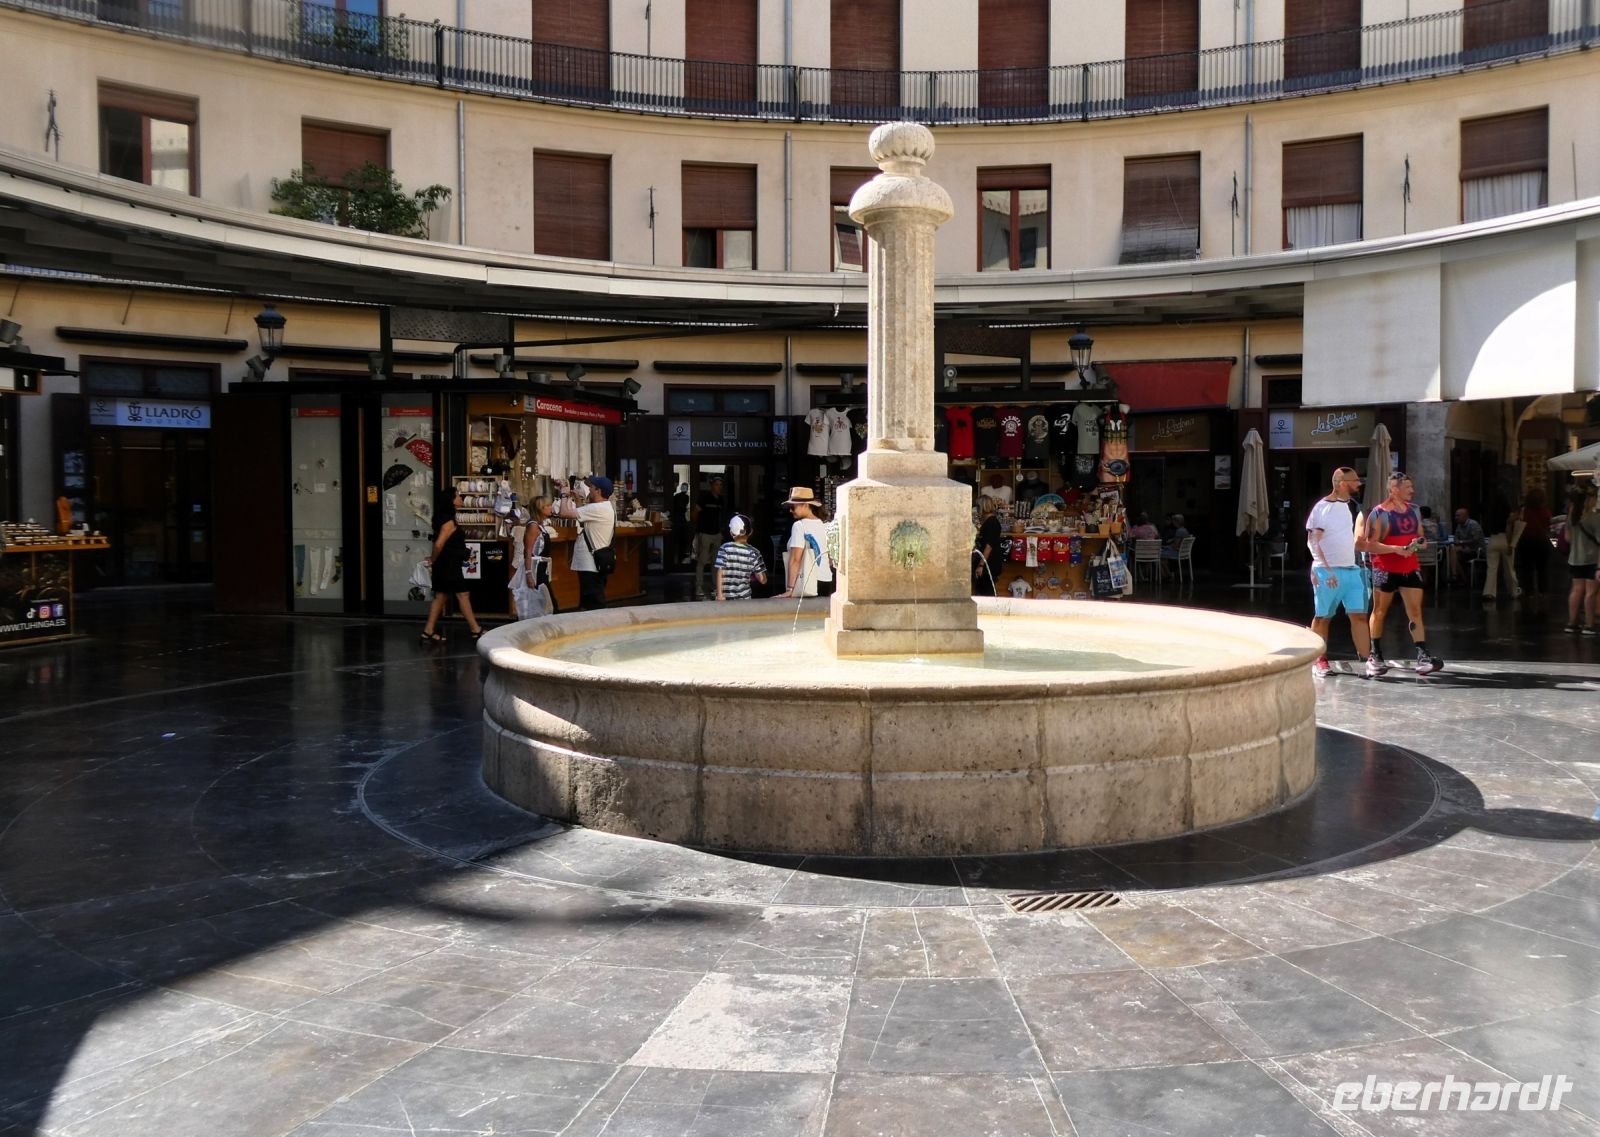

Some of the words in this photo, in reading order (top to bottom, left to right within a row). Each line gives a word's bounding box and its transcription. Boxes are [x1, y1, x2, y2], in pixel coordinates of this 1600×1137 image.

[22, 374, 30, 388] 1
[145, 406, 202, 421] LLADRÓ
[1311, 416, 1334, 436] La
[691, 440, 737, 448] CHIMENEAS
[737, 440, 744, 448] Y
[744, 440, 768, 448] FORJA
